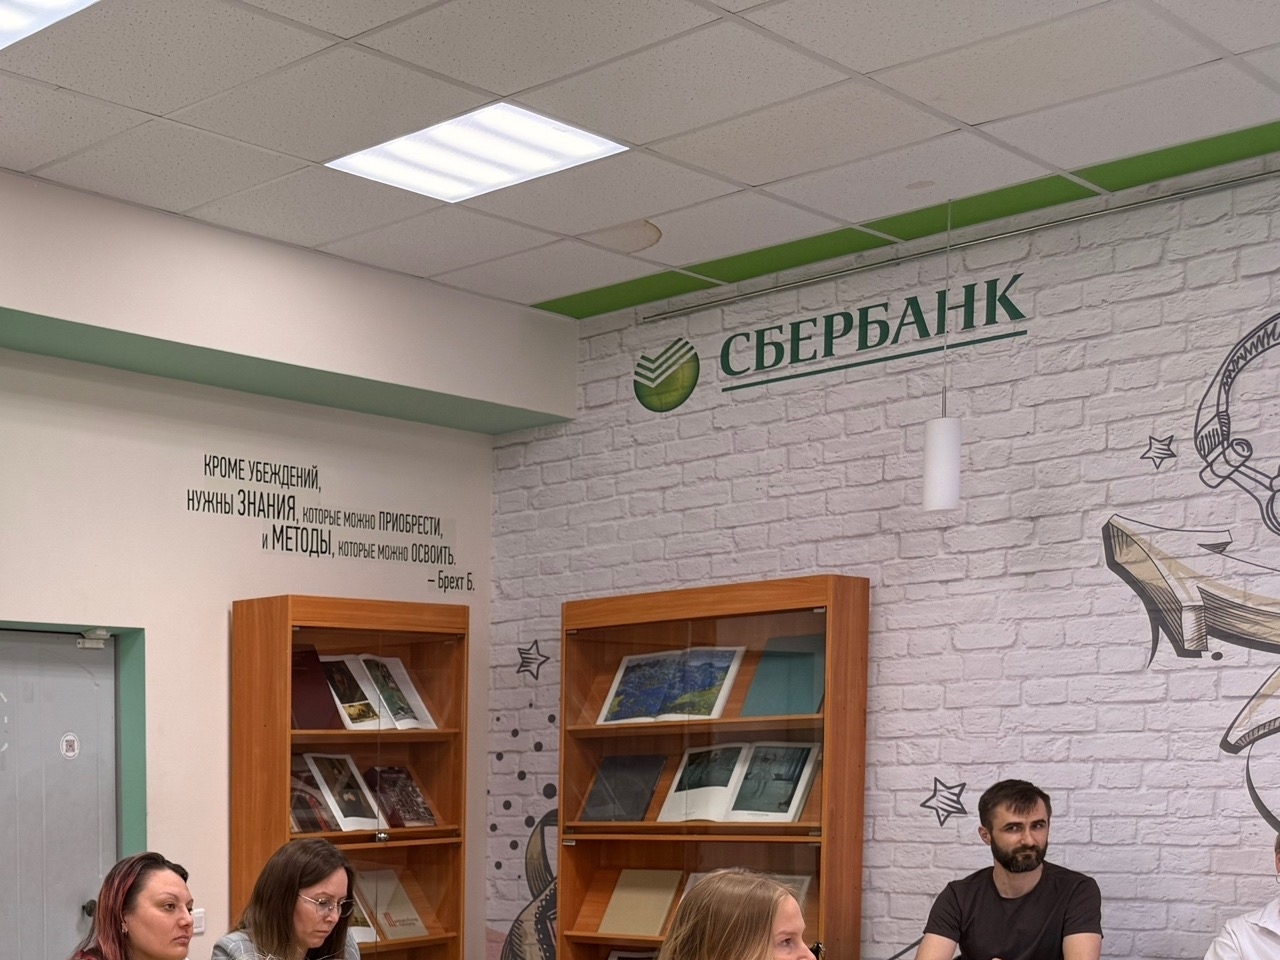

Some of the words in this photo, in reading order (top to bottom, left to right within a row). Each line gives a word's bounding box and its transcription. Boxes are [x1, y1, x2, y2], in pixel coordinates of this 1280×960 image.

[720, 273, 1026, 377] СБЕРБАНК
[204, 454, 245, 481] КРОМЕ
[248, 460, 322, 493] УБЕЖДЕНИЙ,
[187, 489, 234, 515] НУЖНЫ
[237, 490, 299, 525] ЗНАНИЯ,
[302, 506, 342, 527] КОТОРЫЕ
[343, 511, 376, 530] МОЖНО
[378, 511, 443, 539] ПРИОБРЕСТИ,
[272, 524, 335, 559] МЕТОДЫ,
[338, 541, 376, 559] КОТОРЫЕ
[377, 544, 409, 562] МОЖНО
[411, 543, 456, 566] ОСВОИТЬ.
[438, 571, 464, 593] Брехт
[466, 572, 475, 591] Б.
